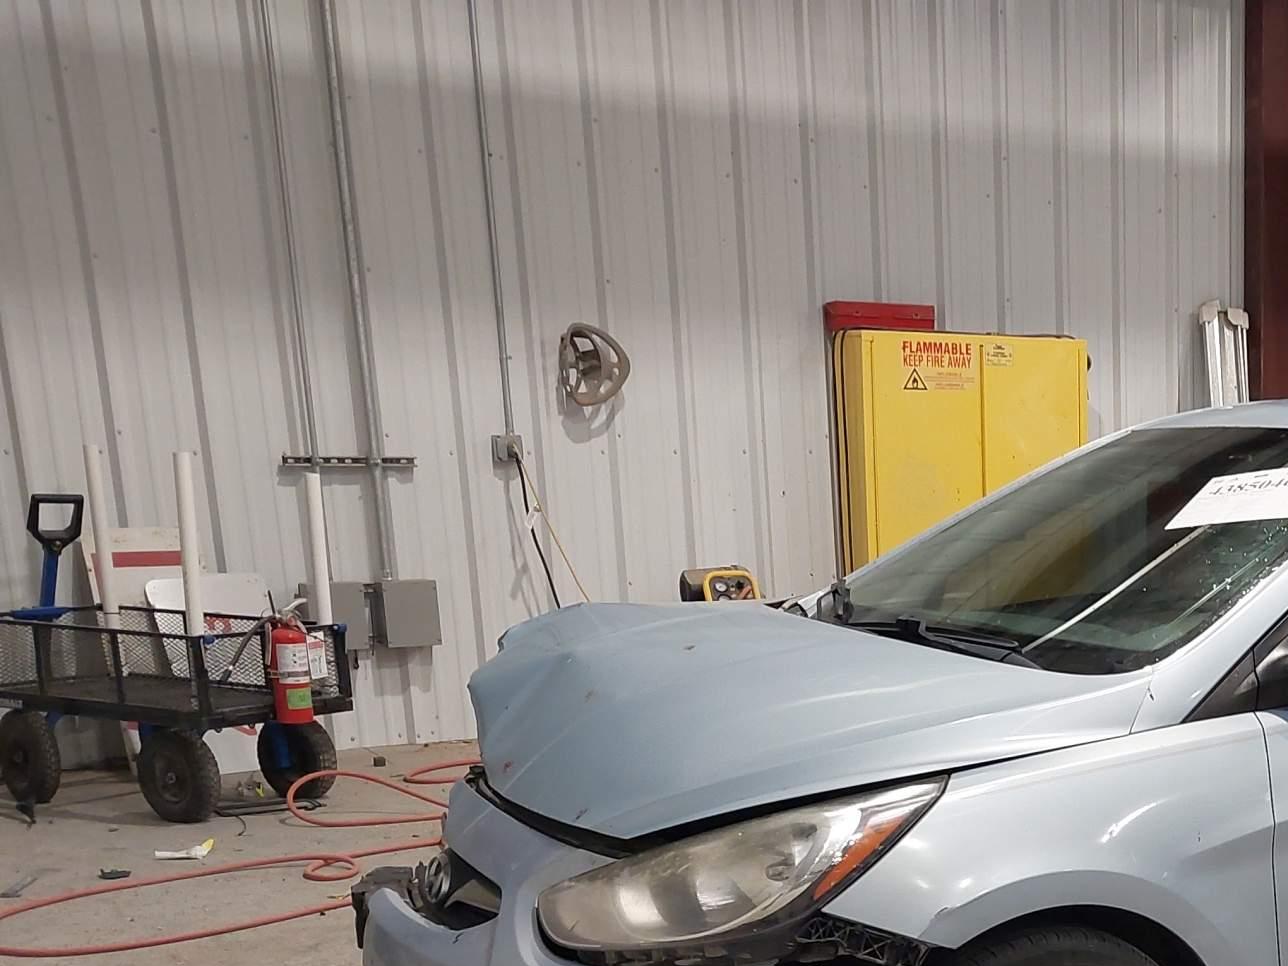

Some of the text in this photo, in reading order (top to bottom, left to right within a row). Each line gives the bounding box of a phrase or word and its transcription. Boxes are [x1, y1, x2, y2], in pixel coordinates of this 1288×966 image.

[902, 340, 972, 356] FLAMMABLE
[903, 354, 924, 368] KEEP
[926, 355, 945, 369] FIRE
[947, 355, 972, 369] AWAY
